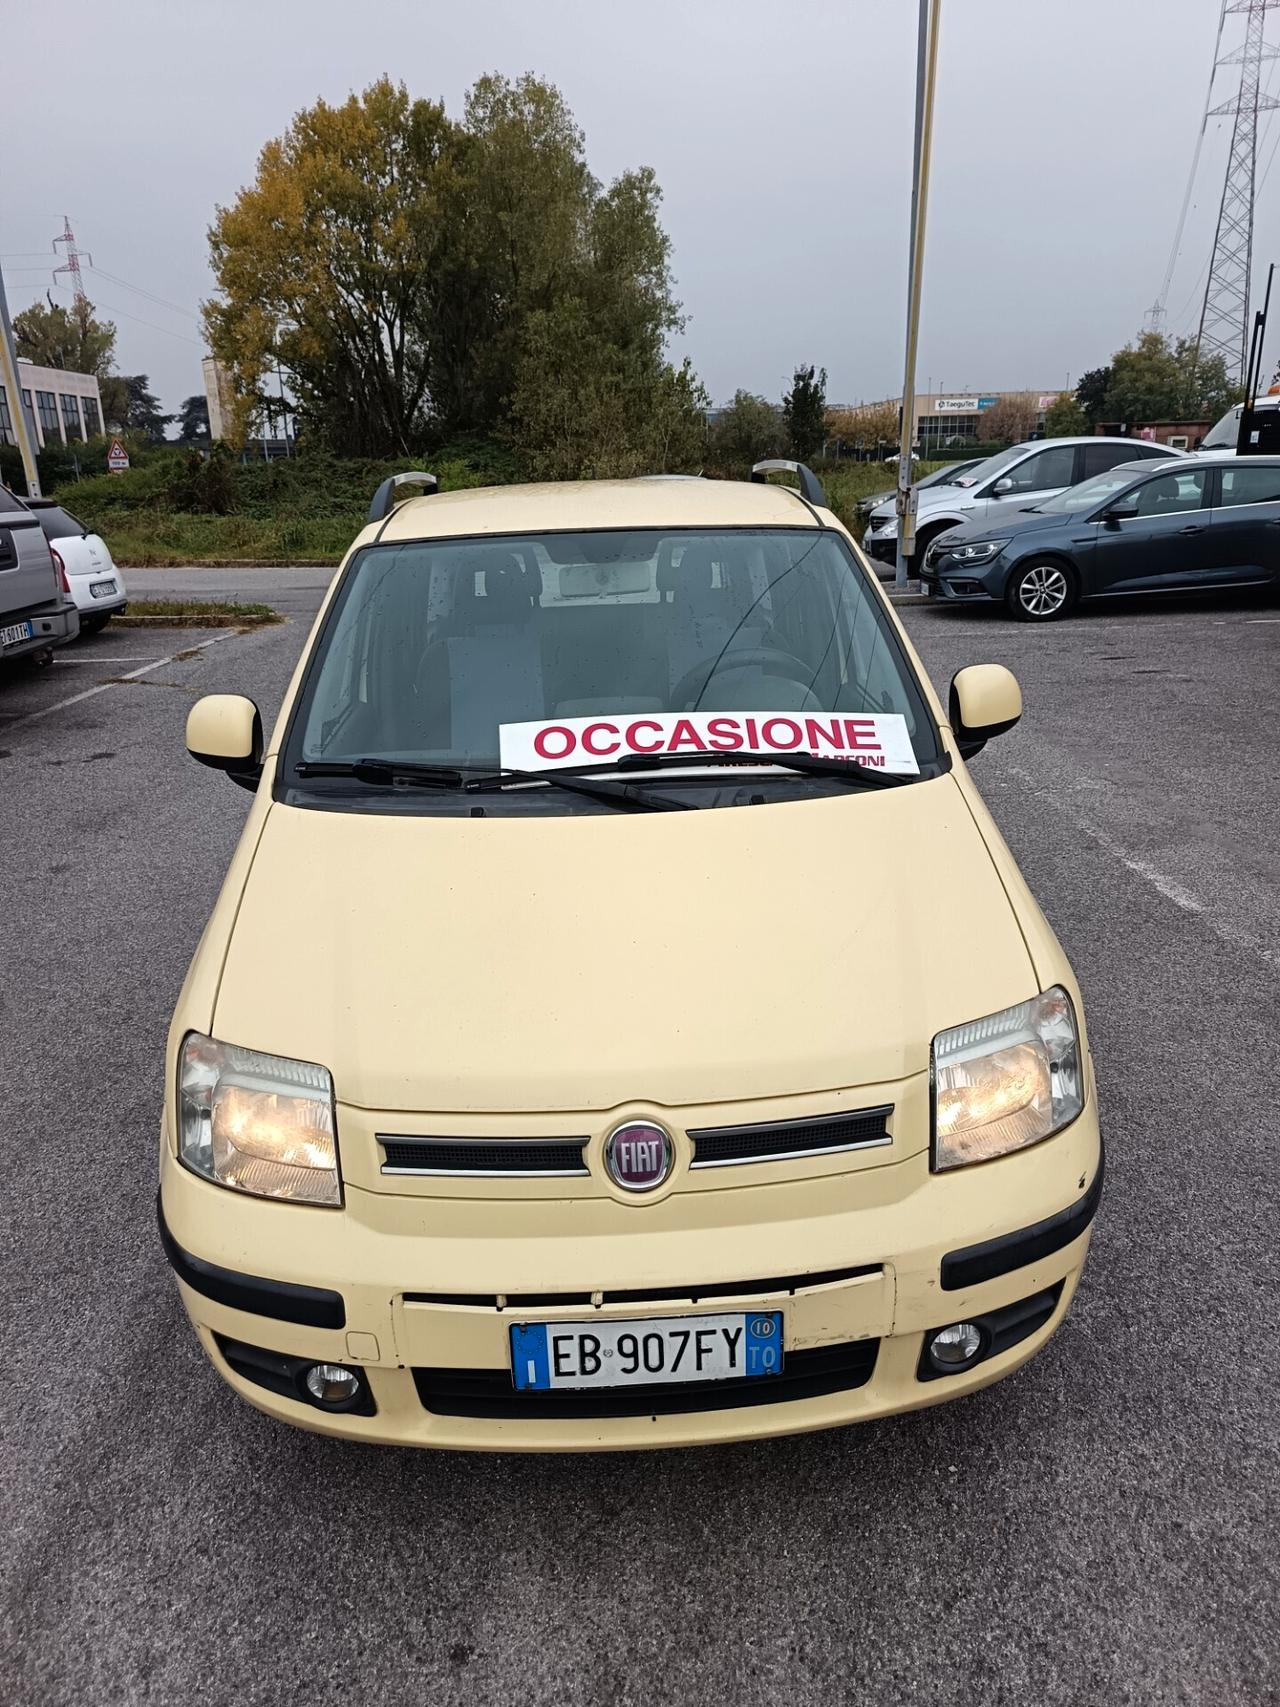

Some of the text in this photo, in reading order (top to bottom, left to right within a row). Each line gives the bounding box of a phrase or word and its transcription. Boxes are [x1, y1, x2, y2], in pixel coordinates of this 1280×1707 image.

[946, 400, 975, 409] TaeguTec
[534, 718, 881, 759] OCCASIONE
[621, 1141, 659, 1173] FIAT
[756, 1322, 770, 1334] 10
